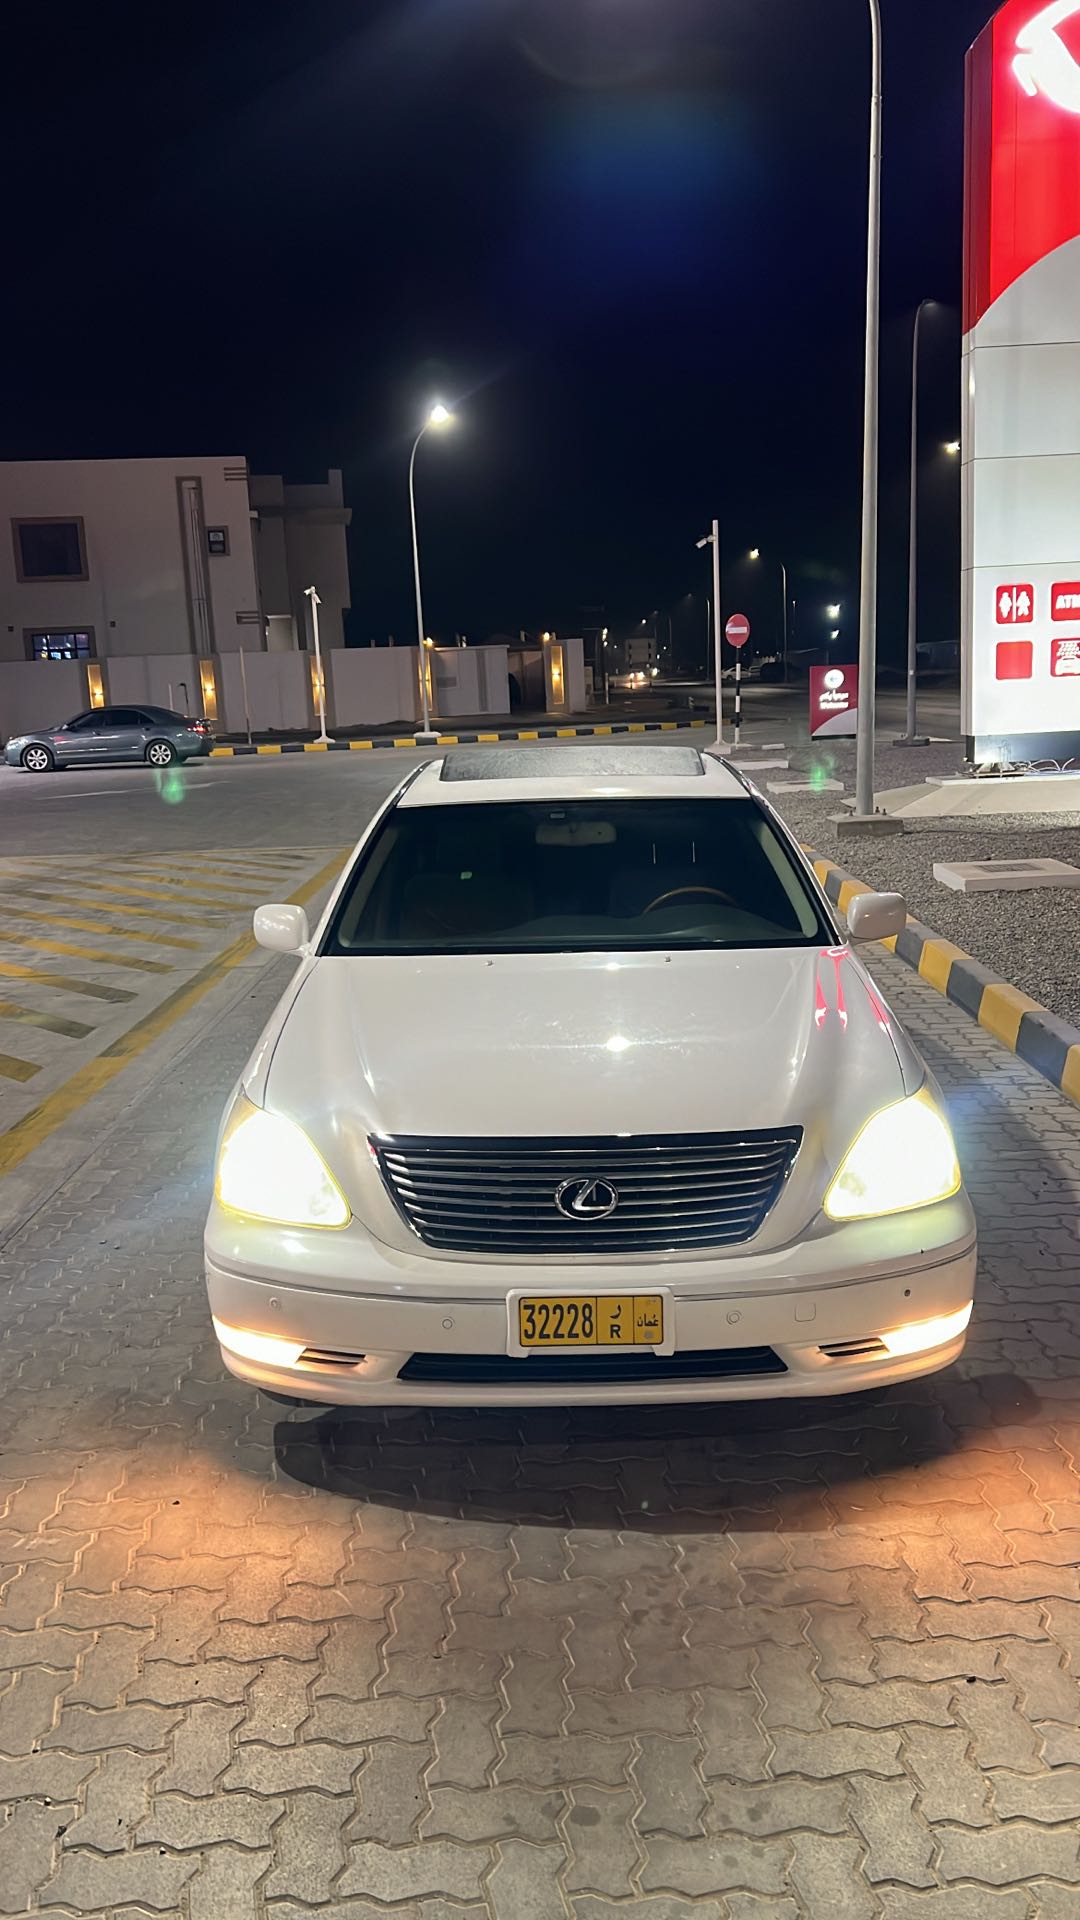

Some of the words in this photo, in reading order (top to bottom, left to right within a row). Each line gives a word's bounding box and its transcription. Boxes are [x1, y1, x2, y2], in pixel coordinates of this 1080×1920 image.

[609, 1304, 622, 1319] ر
[523, 1303, 594, 1339] 32228
[610, 1324, 621, 1339] R
